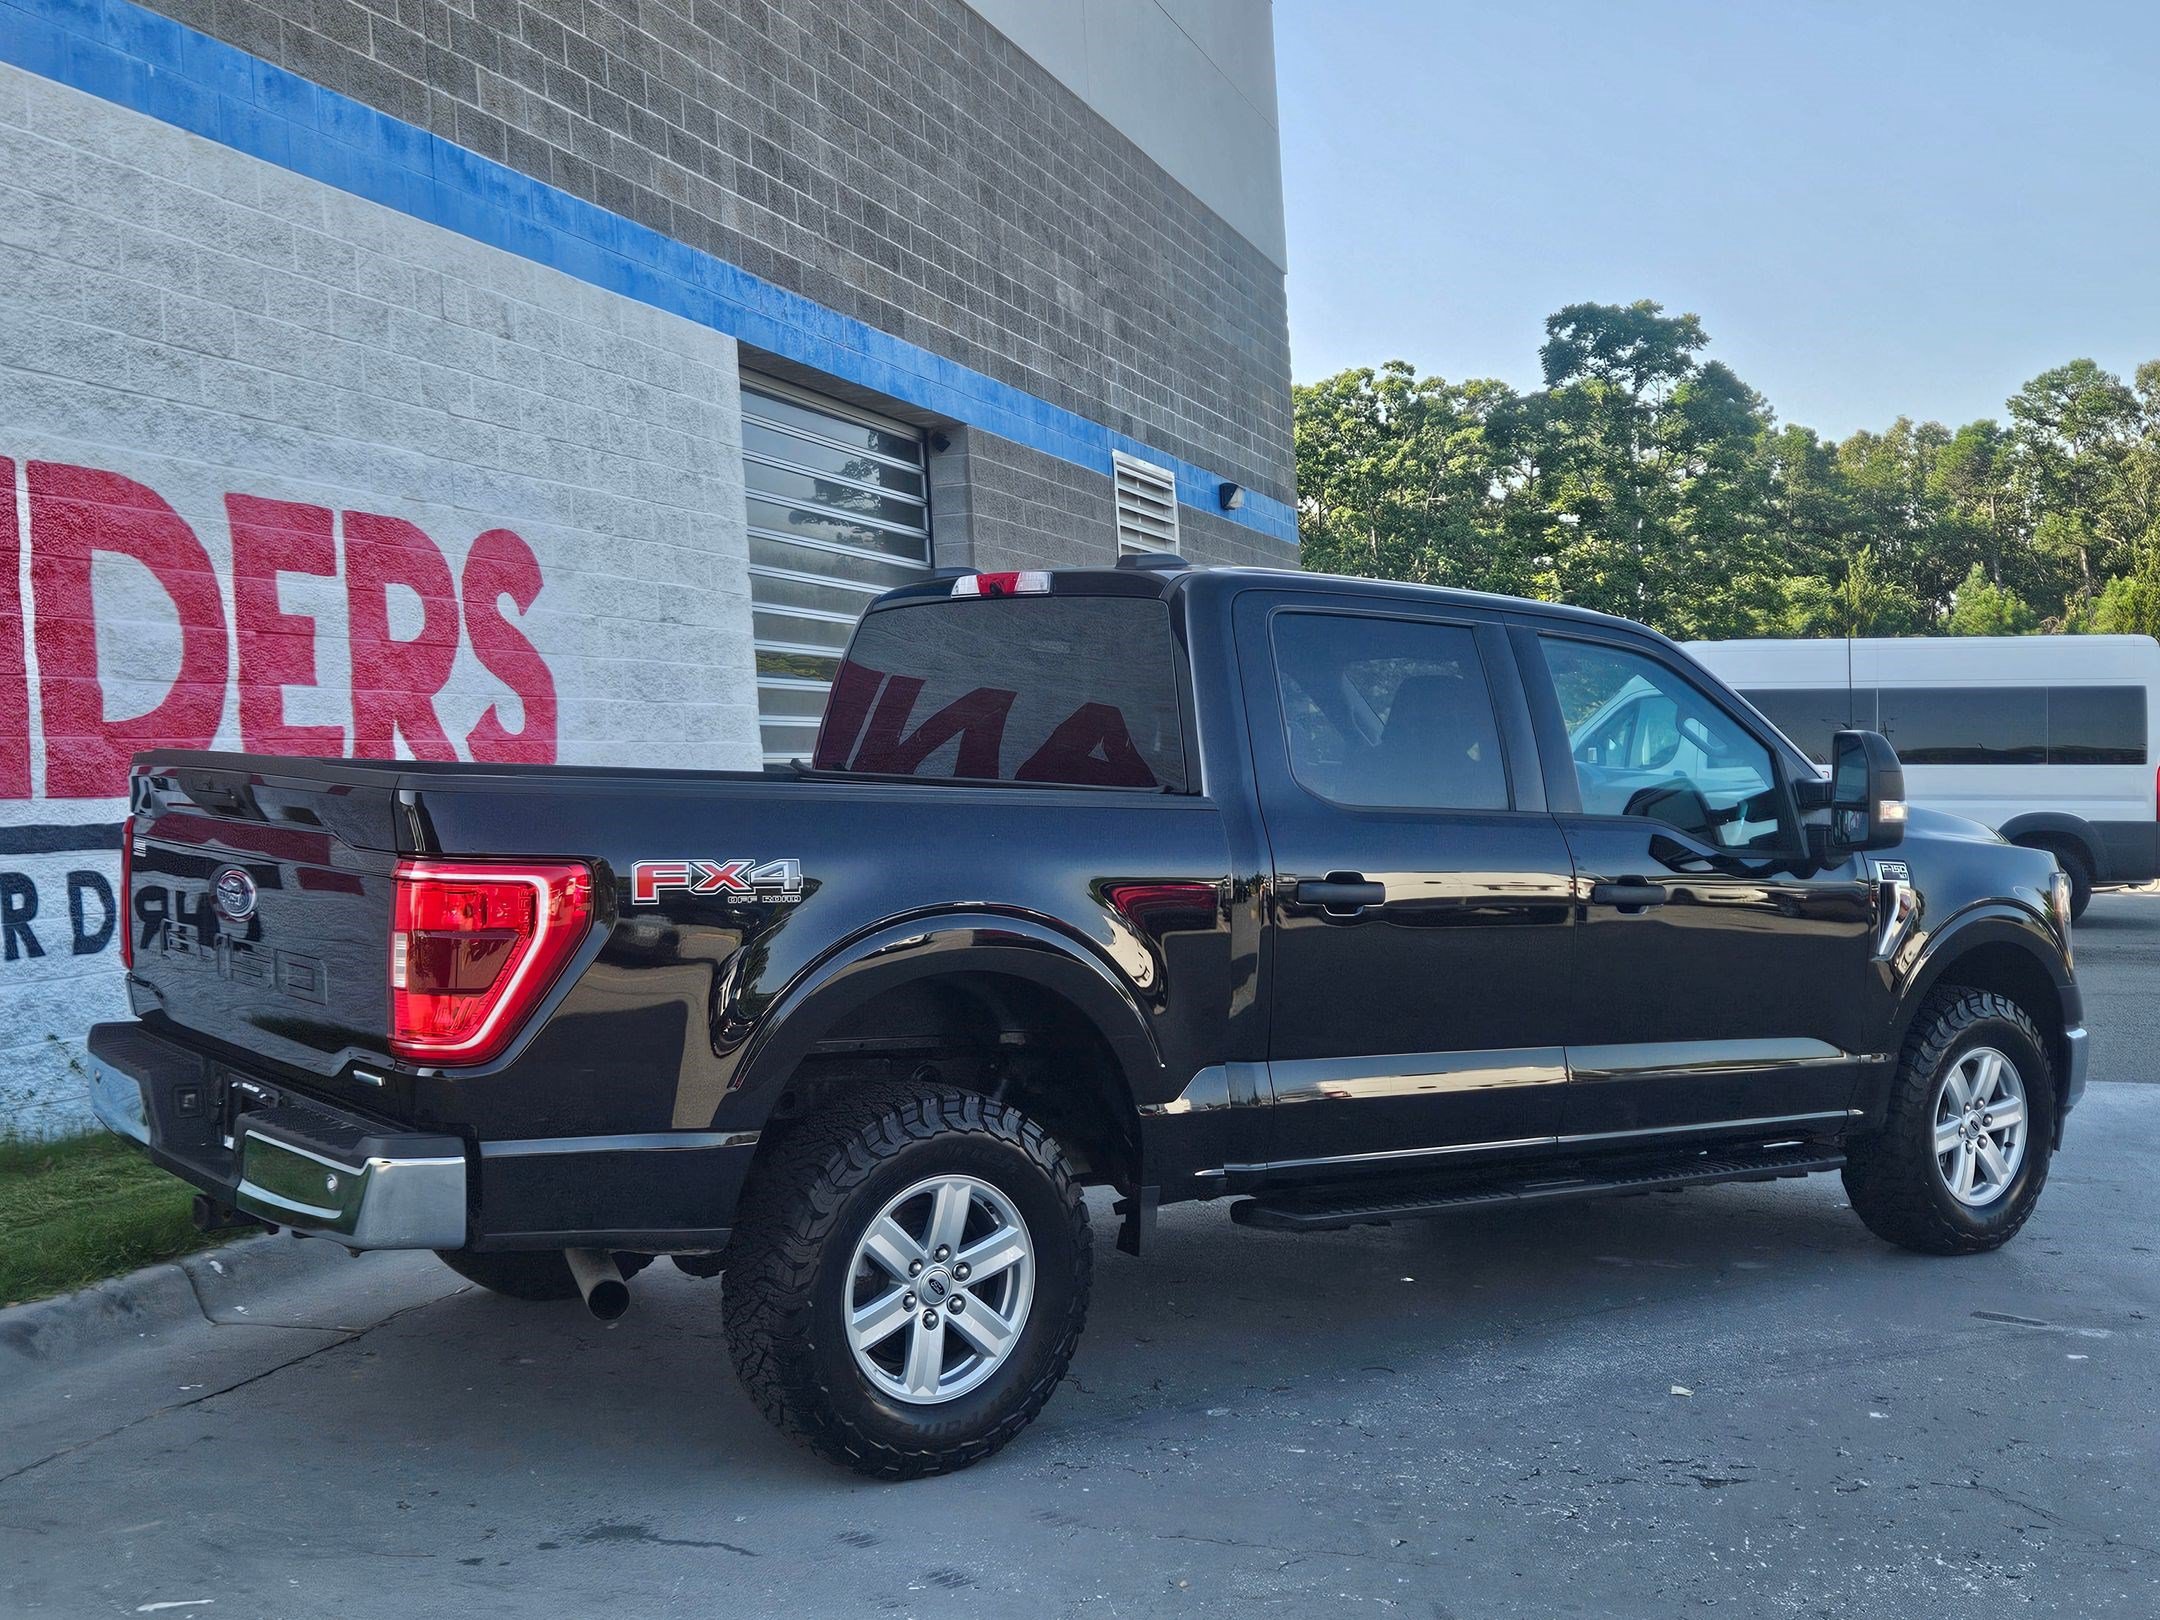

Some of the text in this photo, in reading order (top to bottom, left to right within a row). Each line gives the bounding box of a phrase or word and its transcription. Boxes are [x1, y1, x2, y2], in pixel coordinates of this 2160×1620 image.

[1882, 864, 1907, 873] F-150
[632, 859, 803, 905] FX4
[728, 895, 802, 904] OFF ROAD
